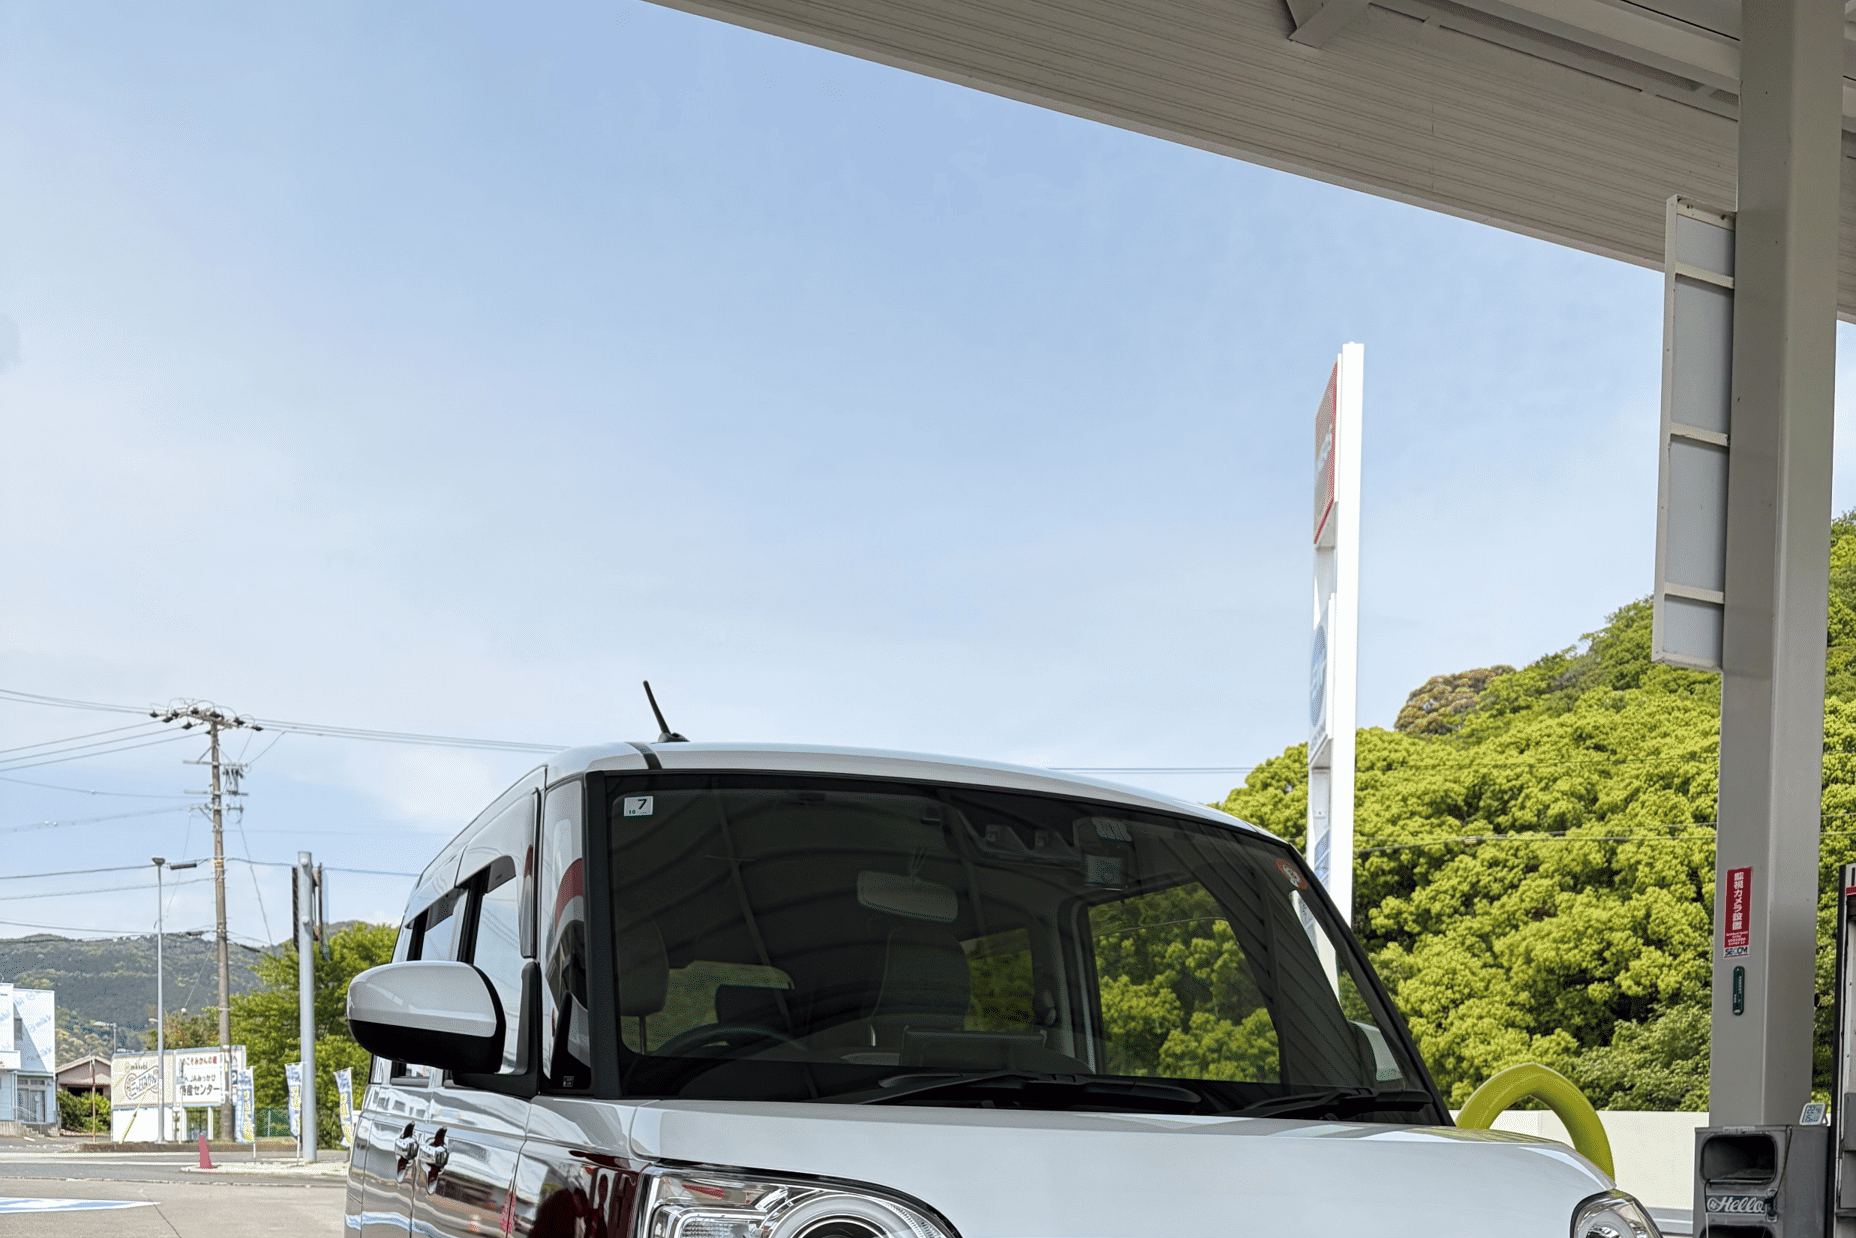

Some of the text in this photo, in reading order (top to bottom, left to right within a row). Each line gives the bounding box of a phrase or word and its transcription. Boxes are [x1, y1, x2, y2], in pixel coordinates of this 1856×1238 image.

[637, 798, 648, 809] 7
[1732, 871, 1745, 931] 監視カメラ設置
[1716, 1196, 1766, 1213] Hello
